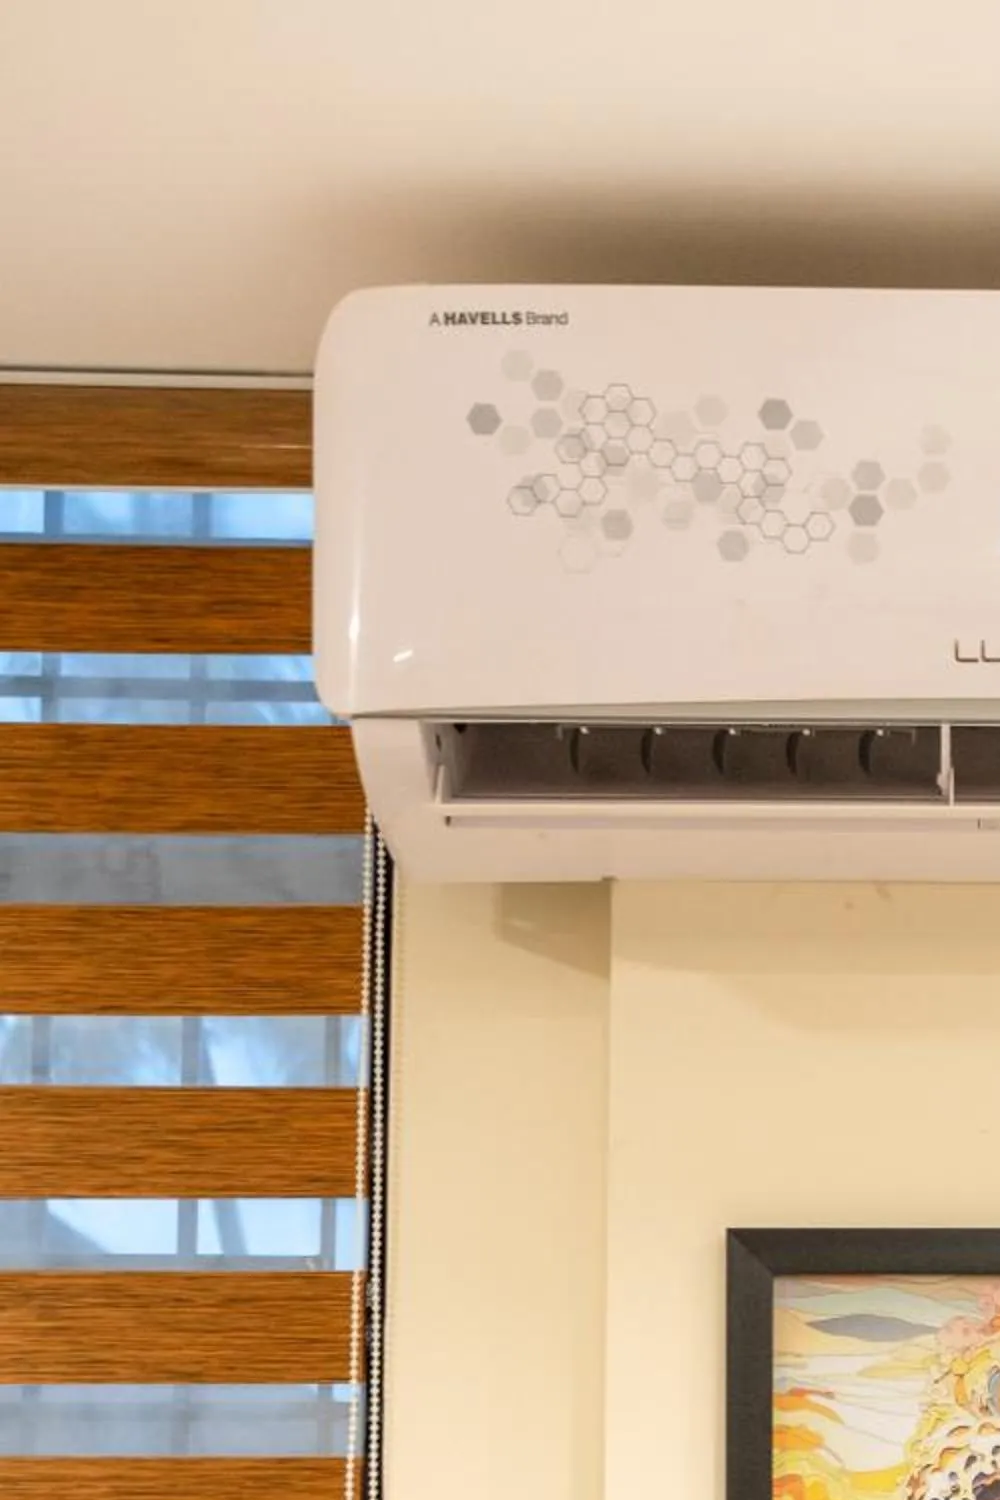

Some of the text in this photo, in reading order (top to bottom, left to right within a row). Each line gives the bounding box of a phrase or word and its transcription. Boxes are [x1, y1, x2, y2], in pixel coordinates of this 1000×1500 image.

[429, 311, 569, 325] A HAVELLS Brand
